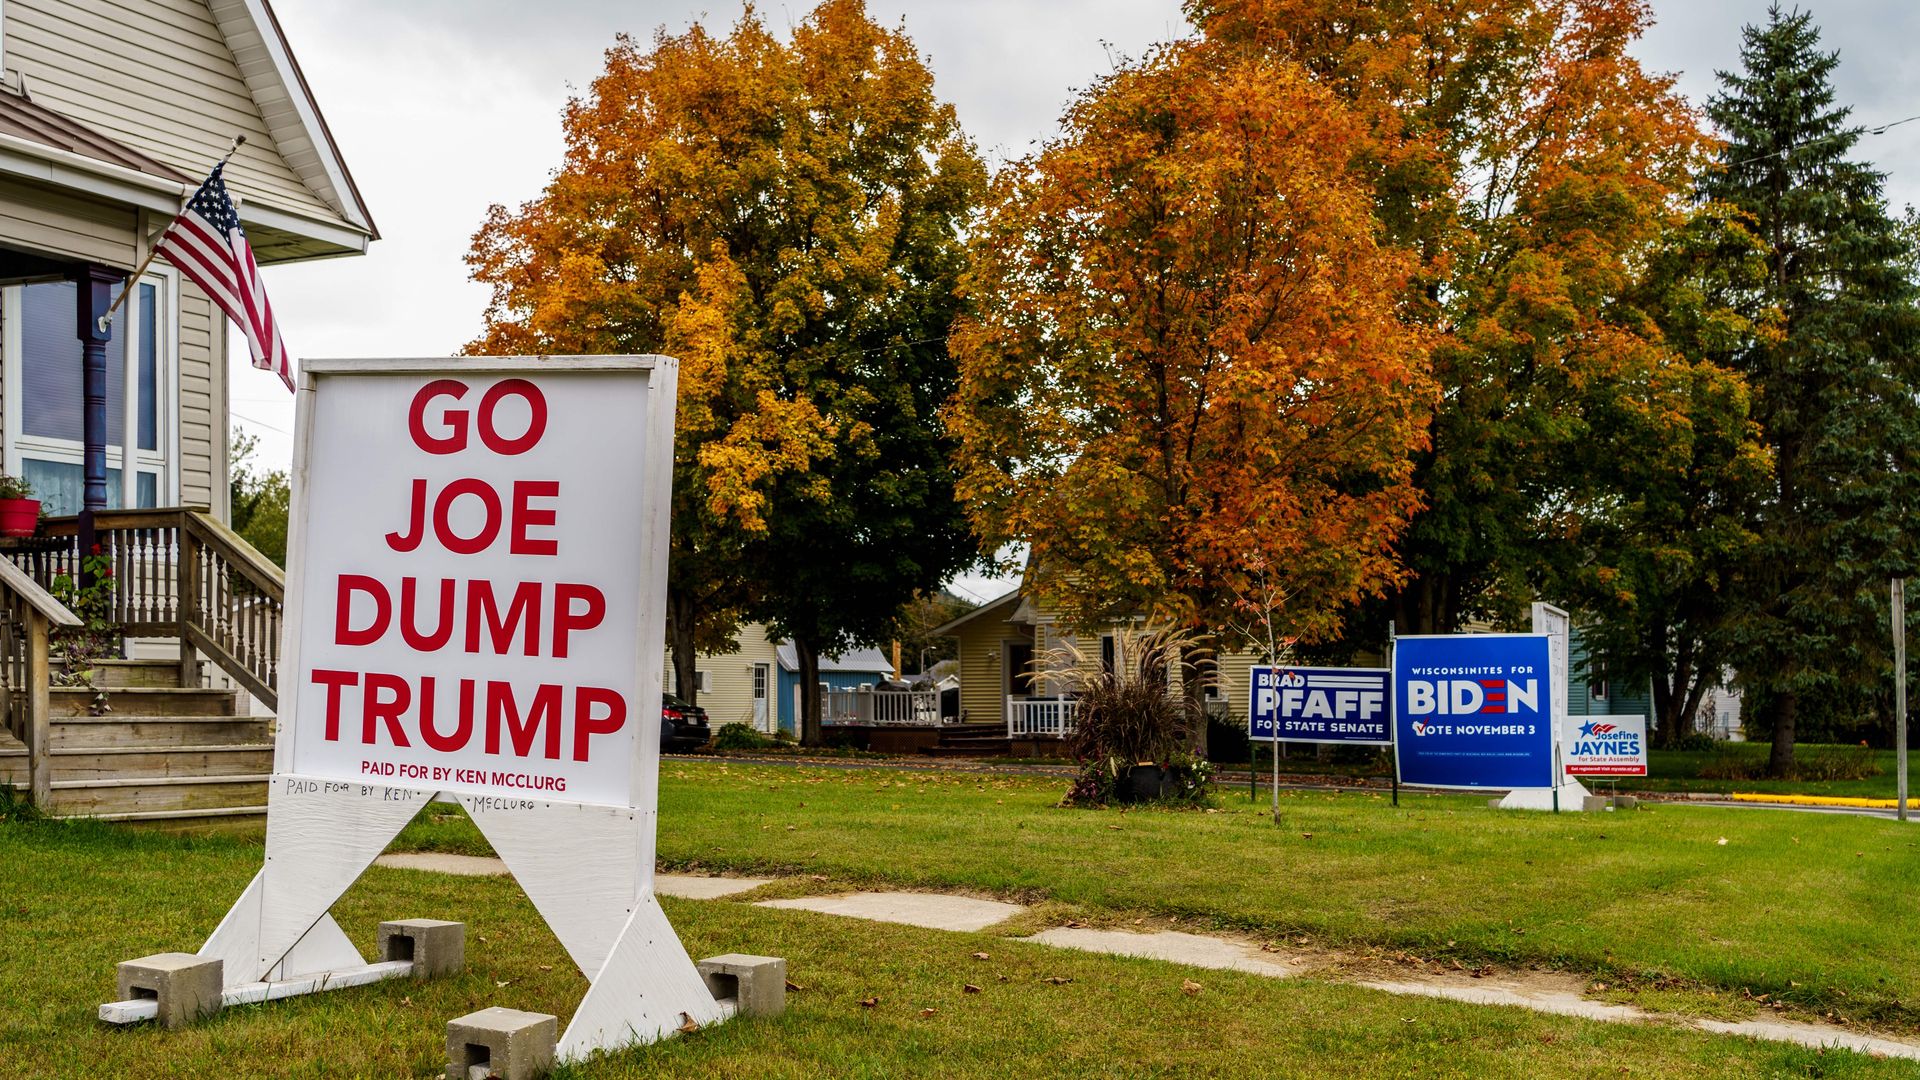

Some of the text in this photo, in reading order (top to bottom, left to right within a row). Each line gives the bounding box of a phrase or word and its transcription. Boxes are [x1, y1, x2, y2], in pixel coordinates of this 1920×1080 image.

[408, 379, 548, 456] GO
[385, 478, 560, 556] JOE
[335, 574, 606, 659] DUMP
[1258, 673, 1305, 688] BRAD
[1411, 665, 1534, 676] WISCONSINITES FOR
[1257, 688, 1384, 720] PFAFF
[1407, 678, 1539, 715] BIDEN
[311, 669, 627, 762] TRUMP
[1285, 721, 1326, 732] STATE
[1330, 723, 1384, 734] SENATE
[1456, 725, 1525, 735] NOVEMBER
[1528, 724, 1536, 735] 3
[1596, 730, 1639, 740] Josefine
[1570, 741, 1641, 756] JAYNES
[286, 778, 318, 795] PAID
[324, 781, 350, 794] FOR
[361, 785, 374, 796] BY
[384, 787, 412, 801] KEN
[362, 761, 566, 792] PAID FOR BY KEN MCCLURG
